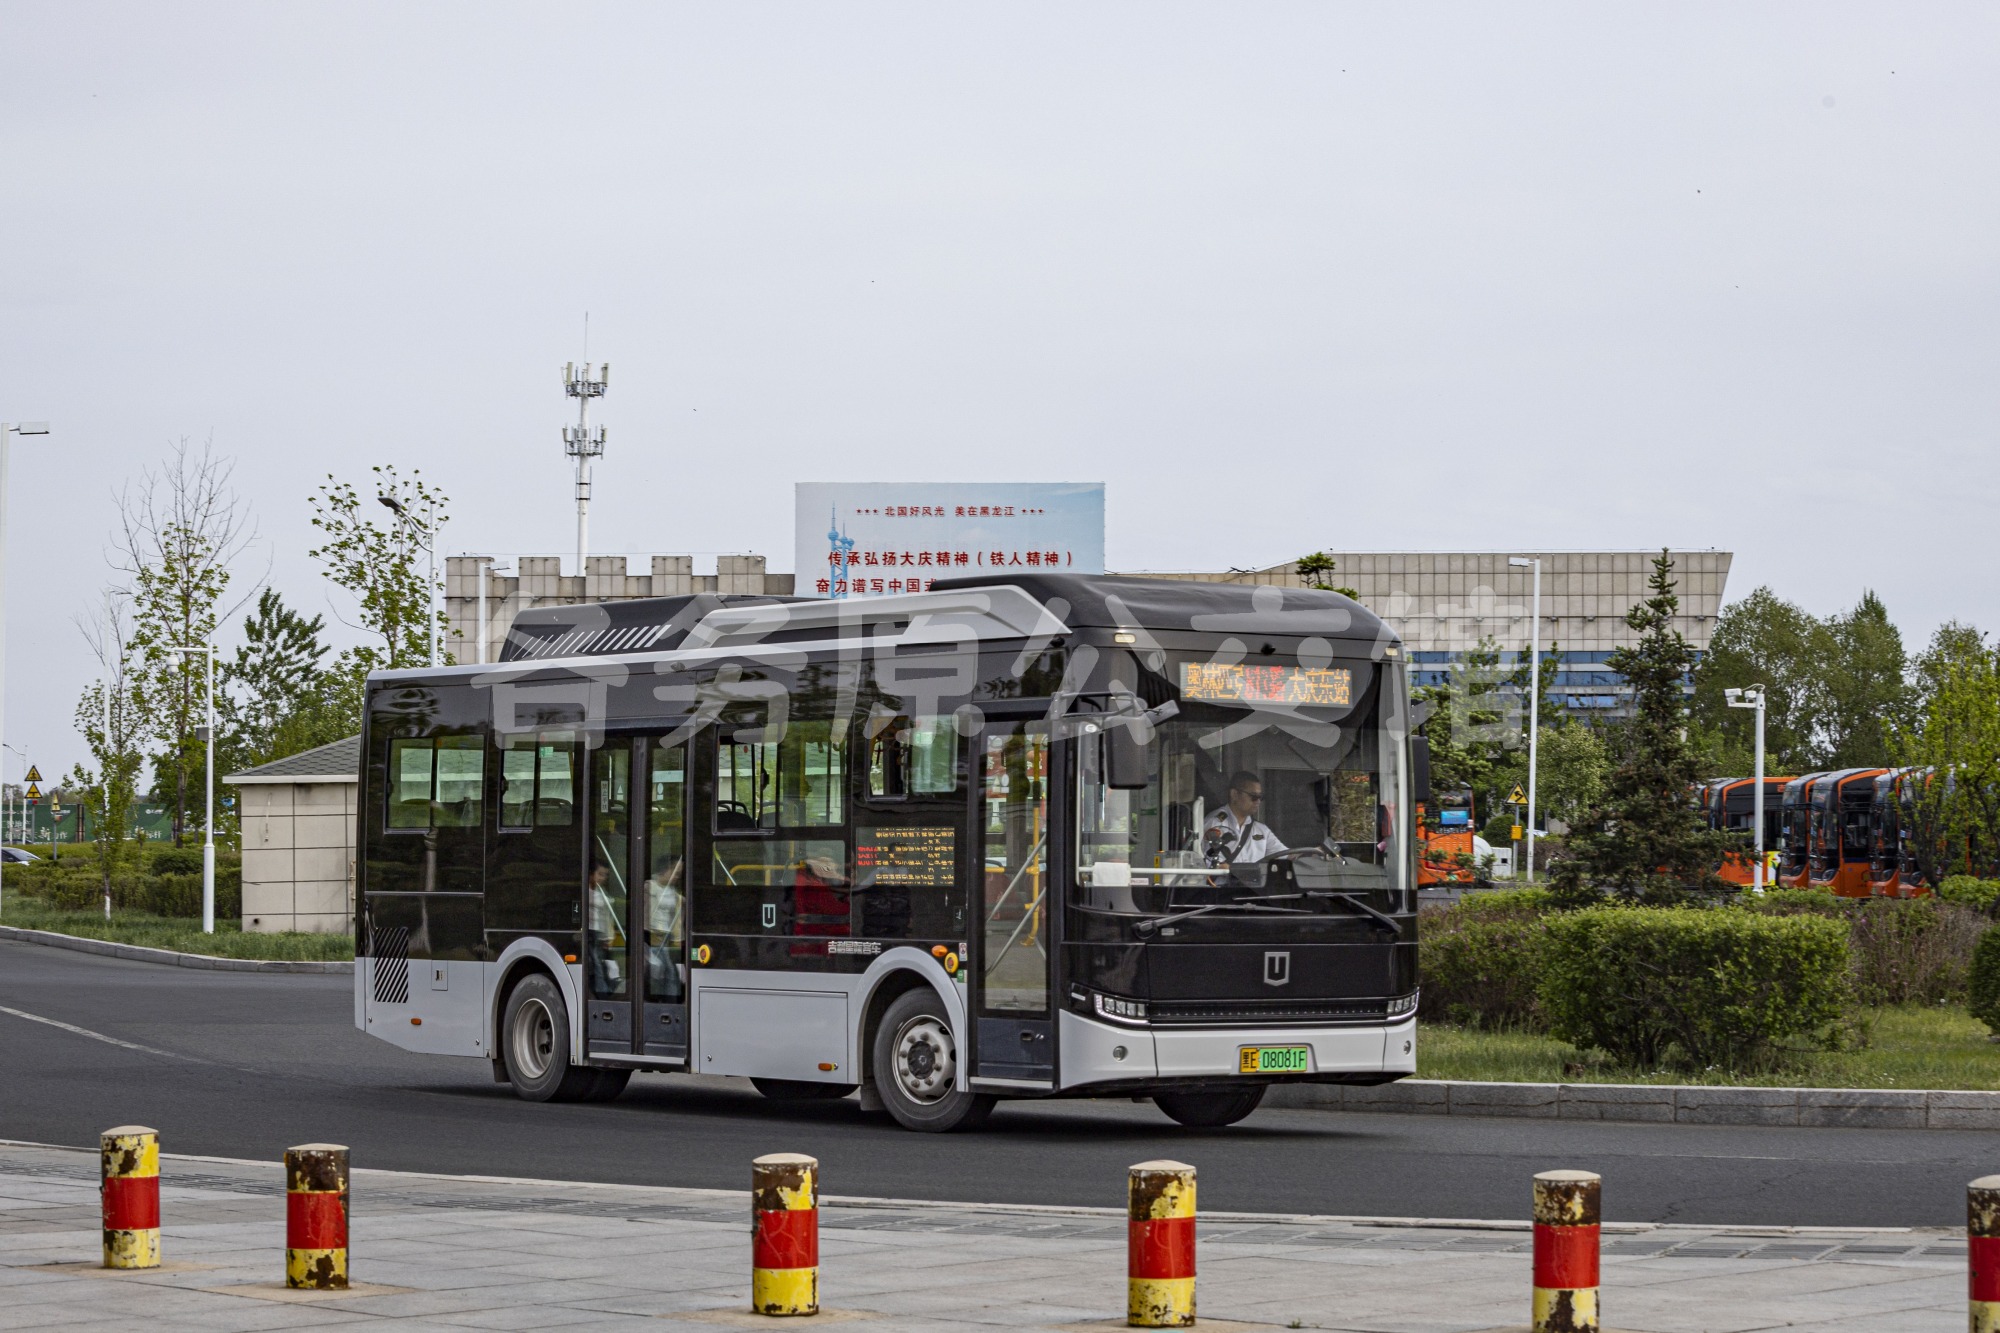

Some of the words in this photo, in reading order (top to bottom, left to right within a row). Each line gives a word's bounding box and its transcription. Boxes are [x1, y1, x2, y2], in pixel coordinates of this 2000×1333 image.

[885, 506, 944, 516] 北国好风光
[955, 506, 1015, 516] 美在黑龙江
[828, 551, 1073, 566] 传承弘扬大庆精神（铁人精神）
